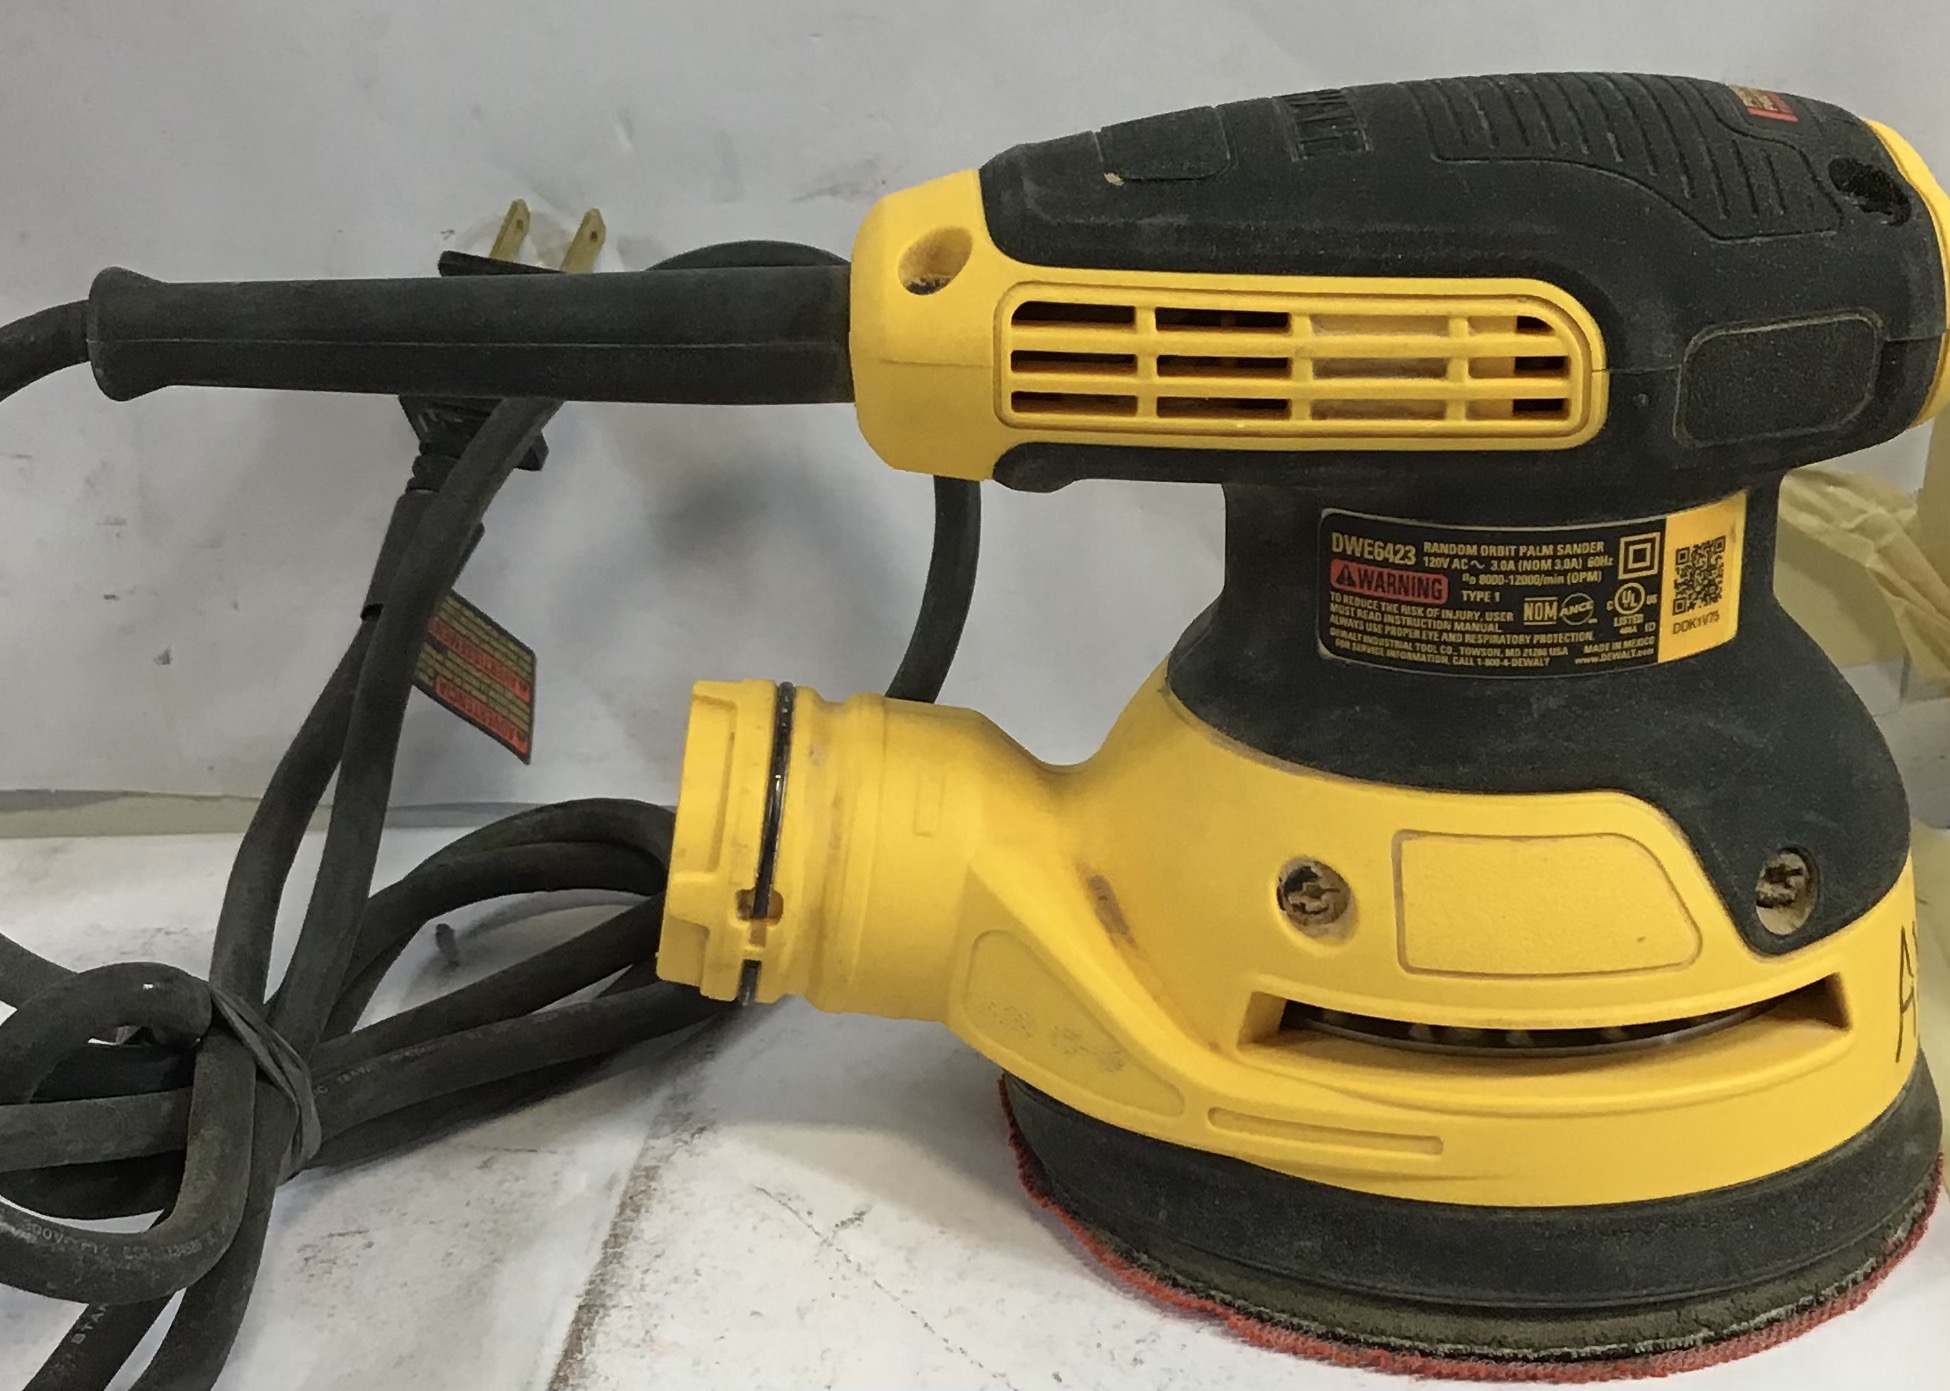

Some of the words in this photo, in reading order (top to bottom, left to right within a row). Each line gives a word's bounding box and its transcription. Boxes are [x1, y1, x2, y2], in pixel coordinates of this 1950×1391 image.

[1331, 532, 1417, 566] DWE6423
[1423, 541, 1478, 556] RANDOM
[1480, 545, 1517, 557] ORBIT
[1519, 545, 1554, 557] PALM
[1557, 541, 1605, 556] SANDER
[1423, 556, 1449, 569] 120V
[1451, 558, 1468, 570] AC
[1490, 560, 1516, 571] 3.0A
[1518, 559, 1552, 572] (NOM
[1587, 555, 1614, 567] 60Hz
[1357, 567, 1443, 600] WARNING
[1566, 571, 1602, 585] (OPM)
[1462, 590, 1492, 602] TYPE
[1330, 591, 1342, 602] TO
[1343, 594, 1379, 610] REDUCE
[1380, 602, 1399, 614] THE
[1400, 604, 1425, 617] RISK
[1426, 607, 1440, 618] OF
[1485, 611, 1514, 622] USER
[1523, 601, 1558, 621] NOM
[1330, 614, 1365, 630] ALWAYS
[1366, 622, 1382, 634] USE
[1385, 625, 1422, 639] PROPER
[1421, 630, 1440, 641] EYE
[1441, 631, 1463, 643] AND
[1465, 634, 1532, 645] RESPIRATORY
[1357, 608, 1383, 621] READ
[1383, 614, 1452, 631] INSTRUCTION
[1363, 634, 1413, 651] INDUSTRIAL
[1415, 642, 1438, 654] TOOL
[1584, 642, 1611, 654] MADE
[1612, 641, 1622, 652] IN
[1623, 636, 1656, 650] MEXICO
[1453, 657, 1475, 667] CALL
